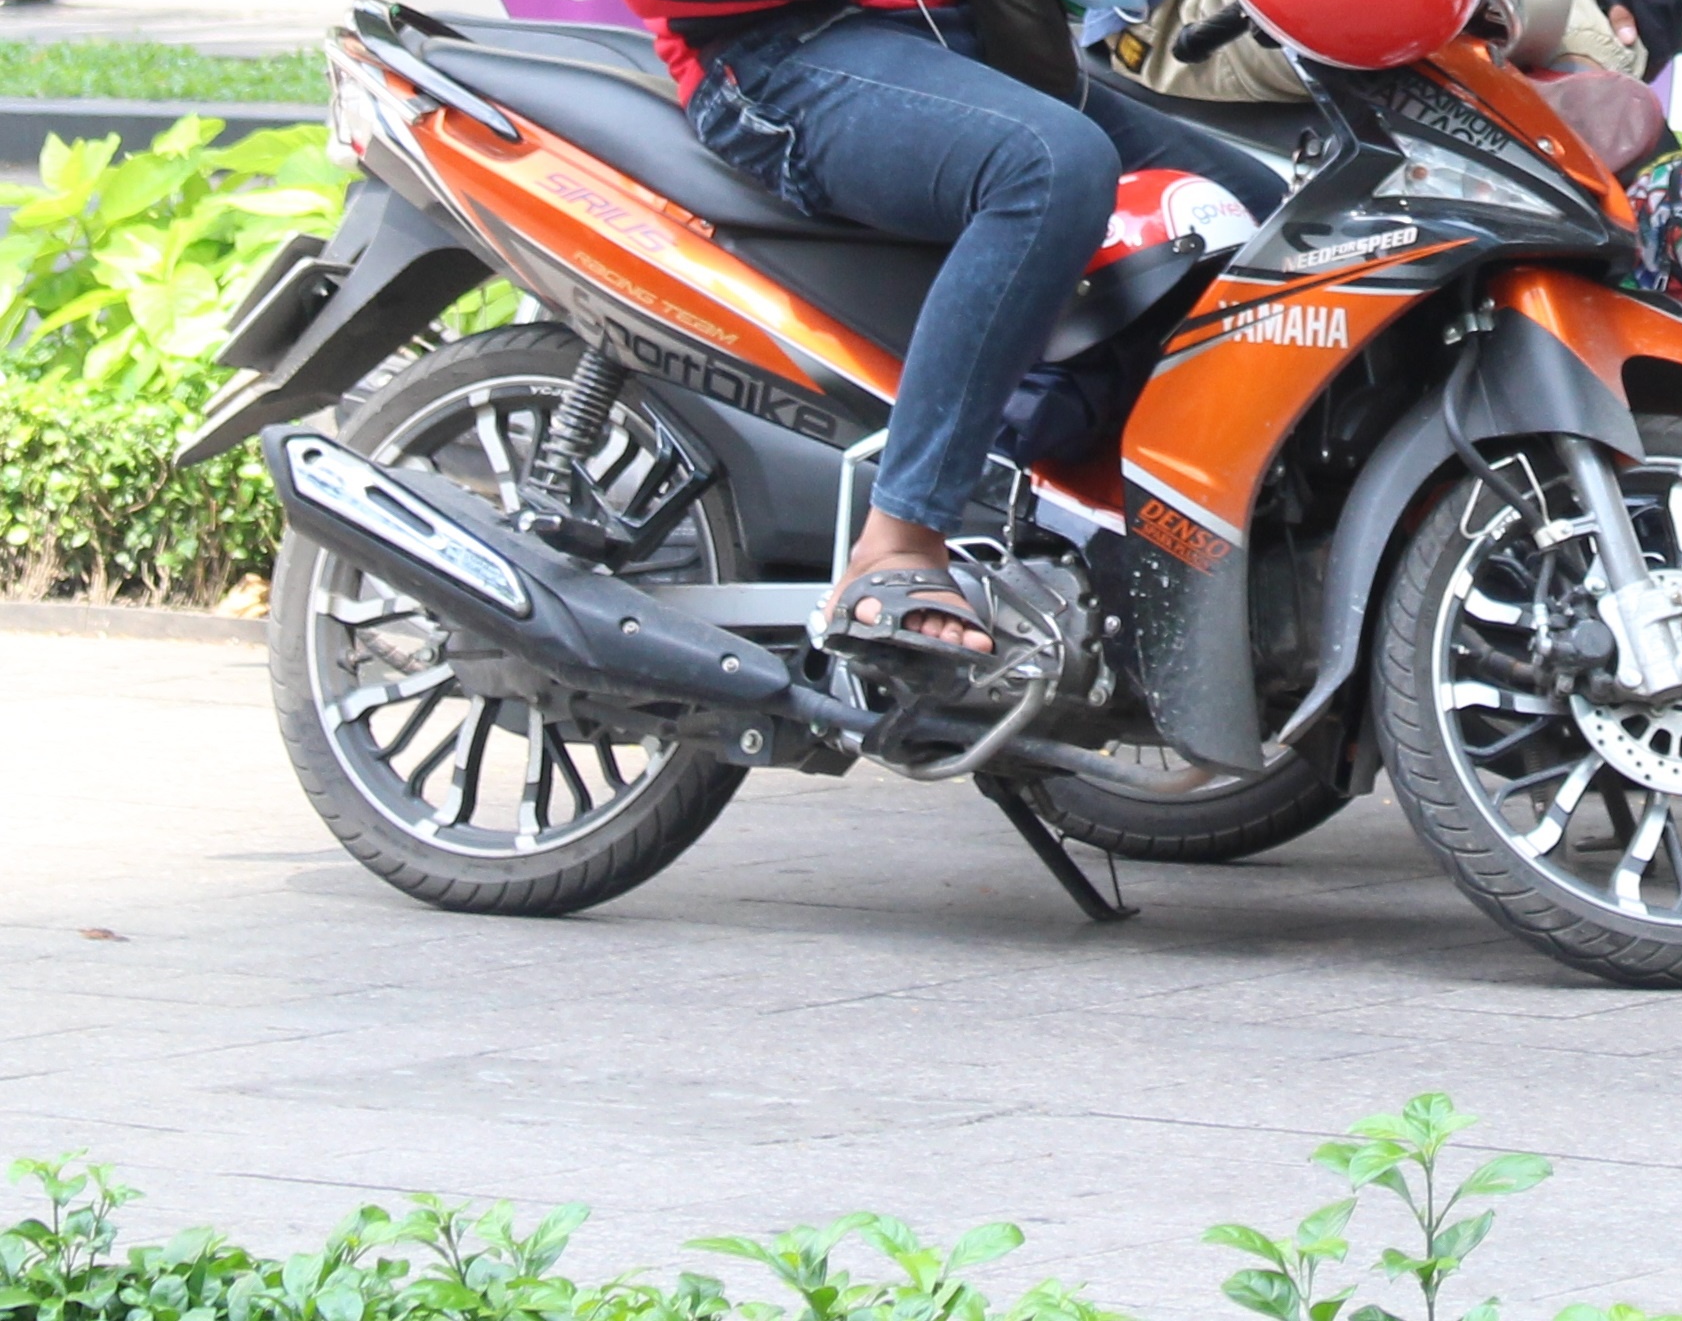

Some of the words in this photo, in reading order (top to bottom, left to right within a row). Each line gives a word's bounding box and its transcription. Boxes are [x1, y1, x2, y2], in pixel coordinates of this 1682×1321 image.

[535, 172, 678, 253] SIRIUS
[1218, 299, 1349, 350] YAMAHA
[1137, 498, 1233, 559] DENSO
